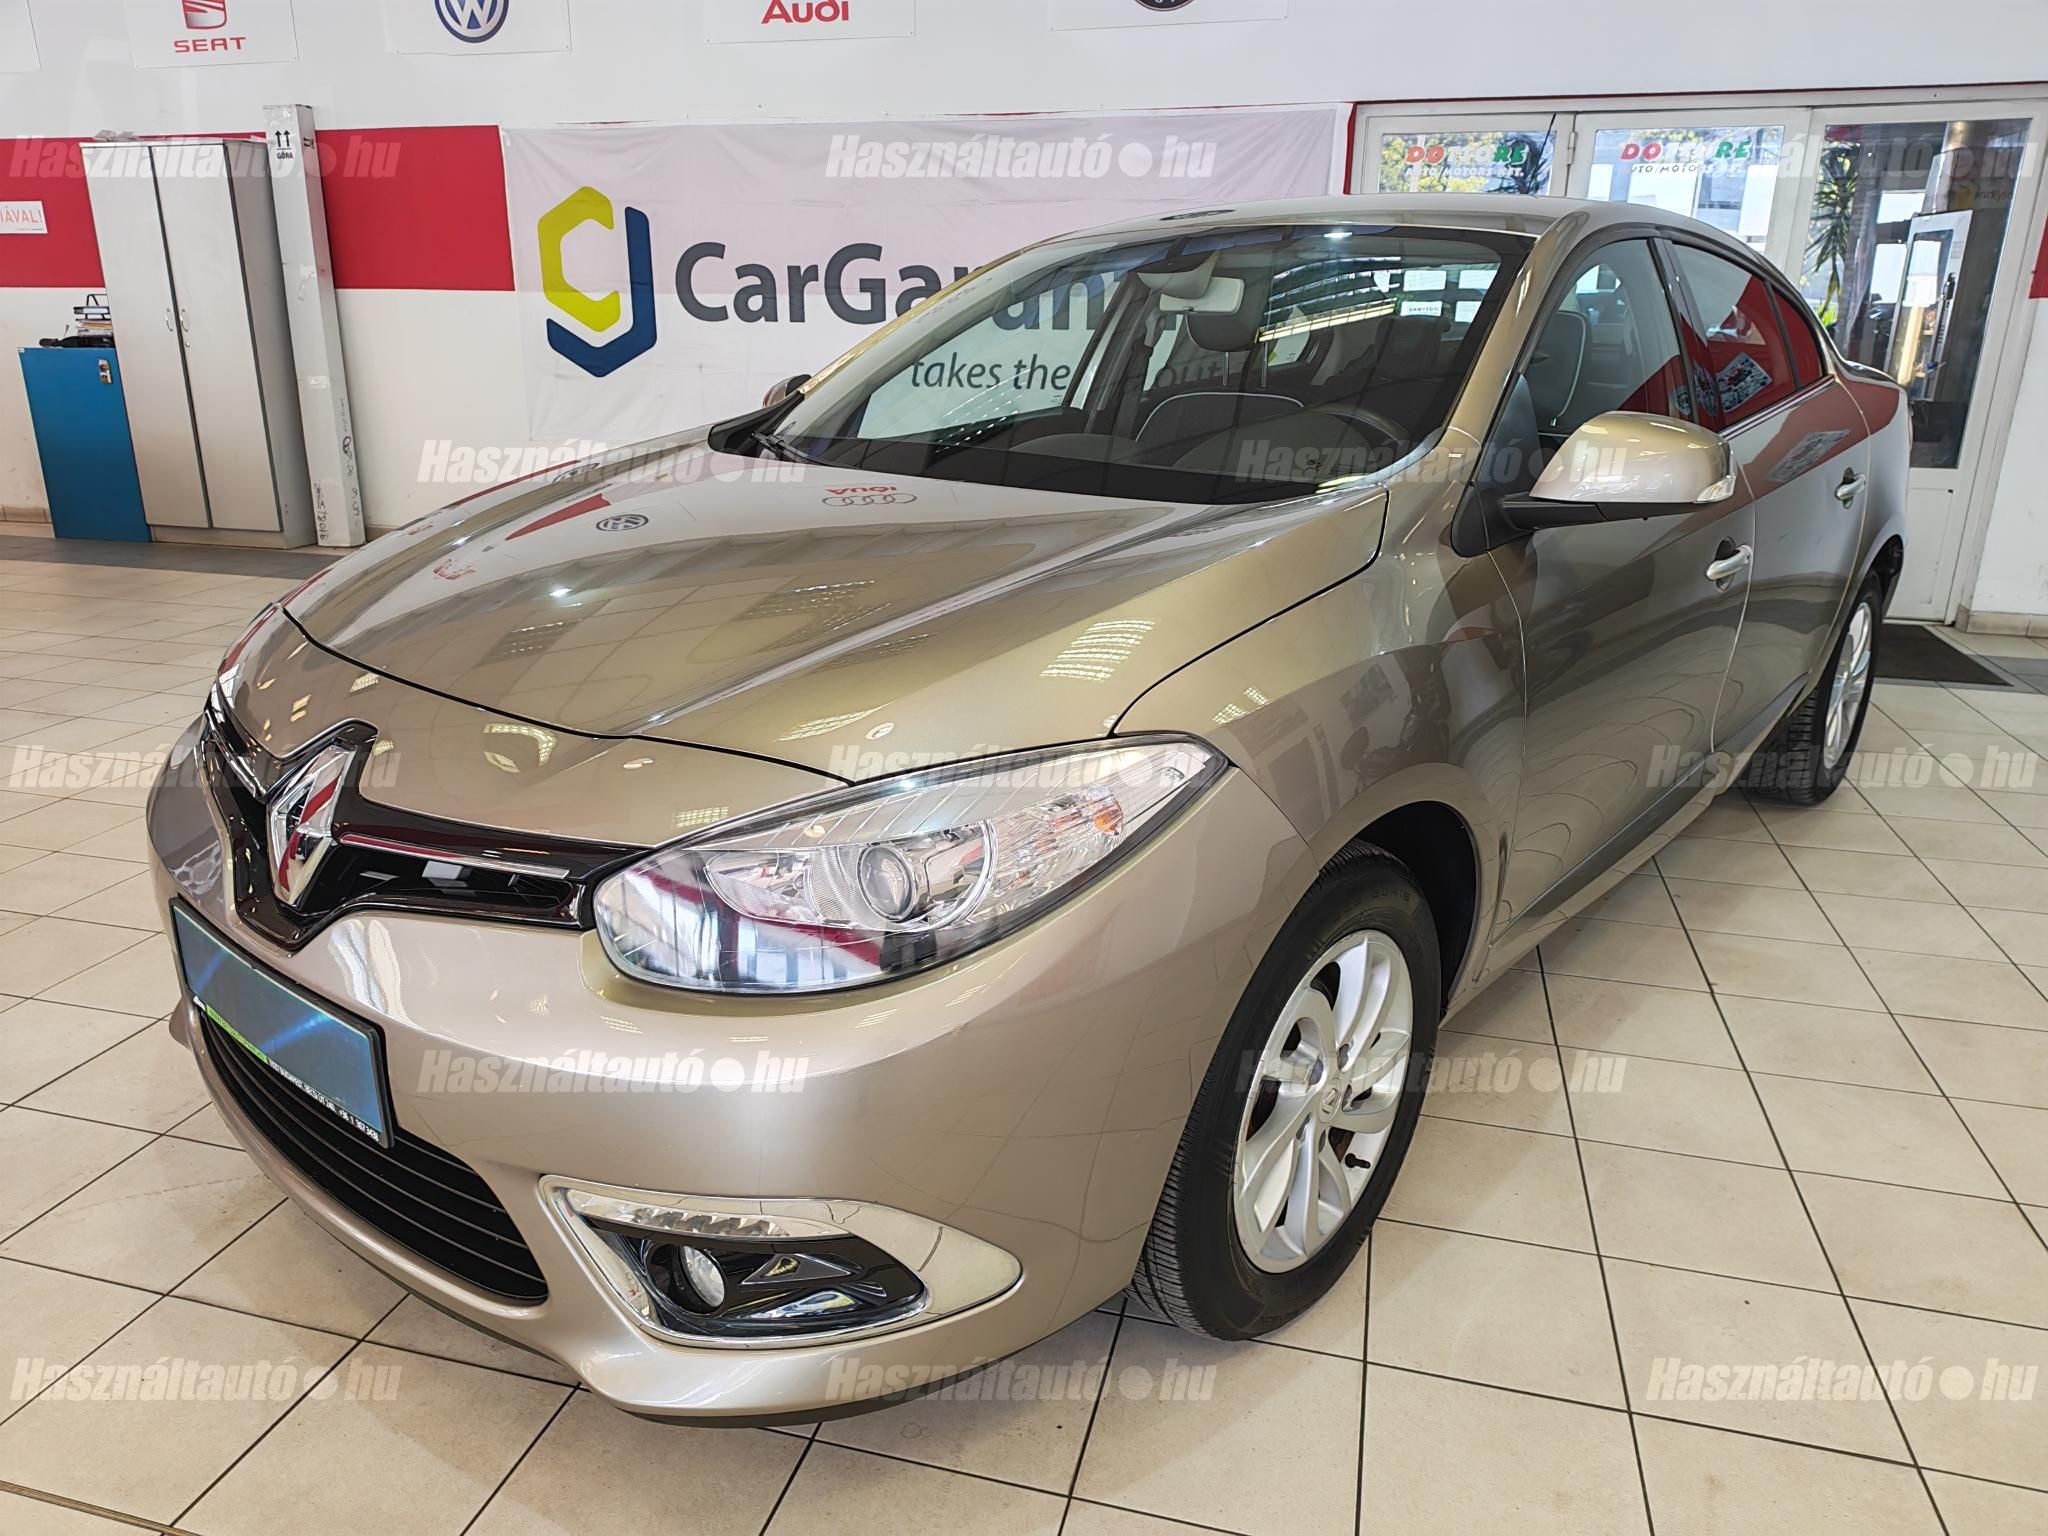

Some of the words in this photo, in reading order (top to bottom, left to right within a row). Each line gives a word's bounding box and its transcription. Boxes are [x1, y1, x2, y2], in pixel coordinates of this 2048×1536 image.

[173, 36, 246, 53] SEAT
[1406, 144, 1529, 164] DOTTORE
[911, 351, 1001, 389] takes
[1013, 353, 1070, 391] the
